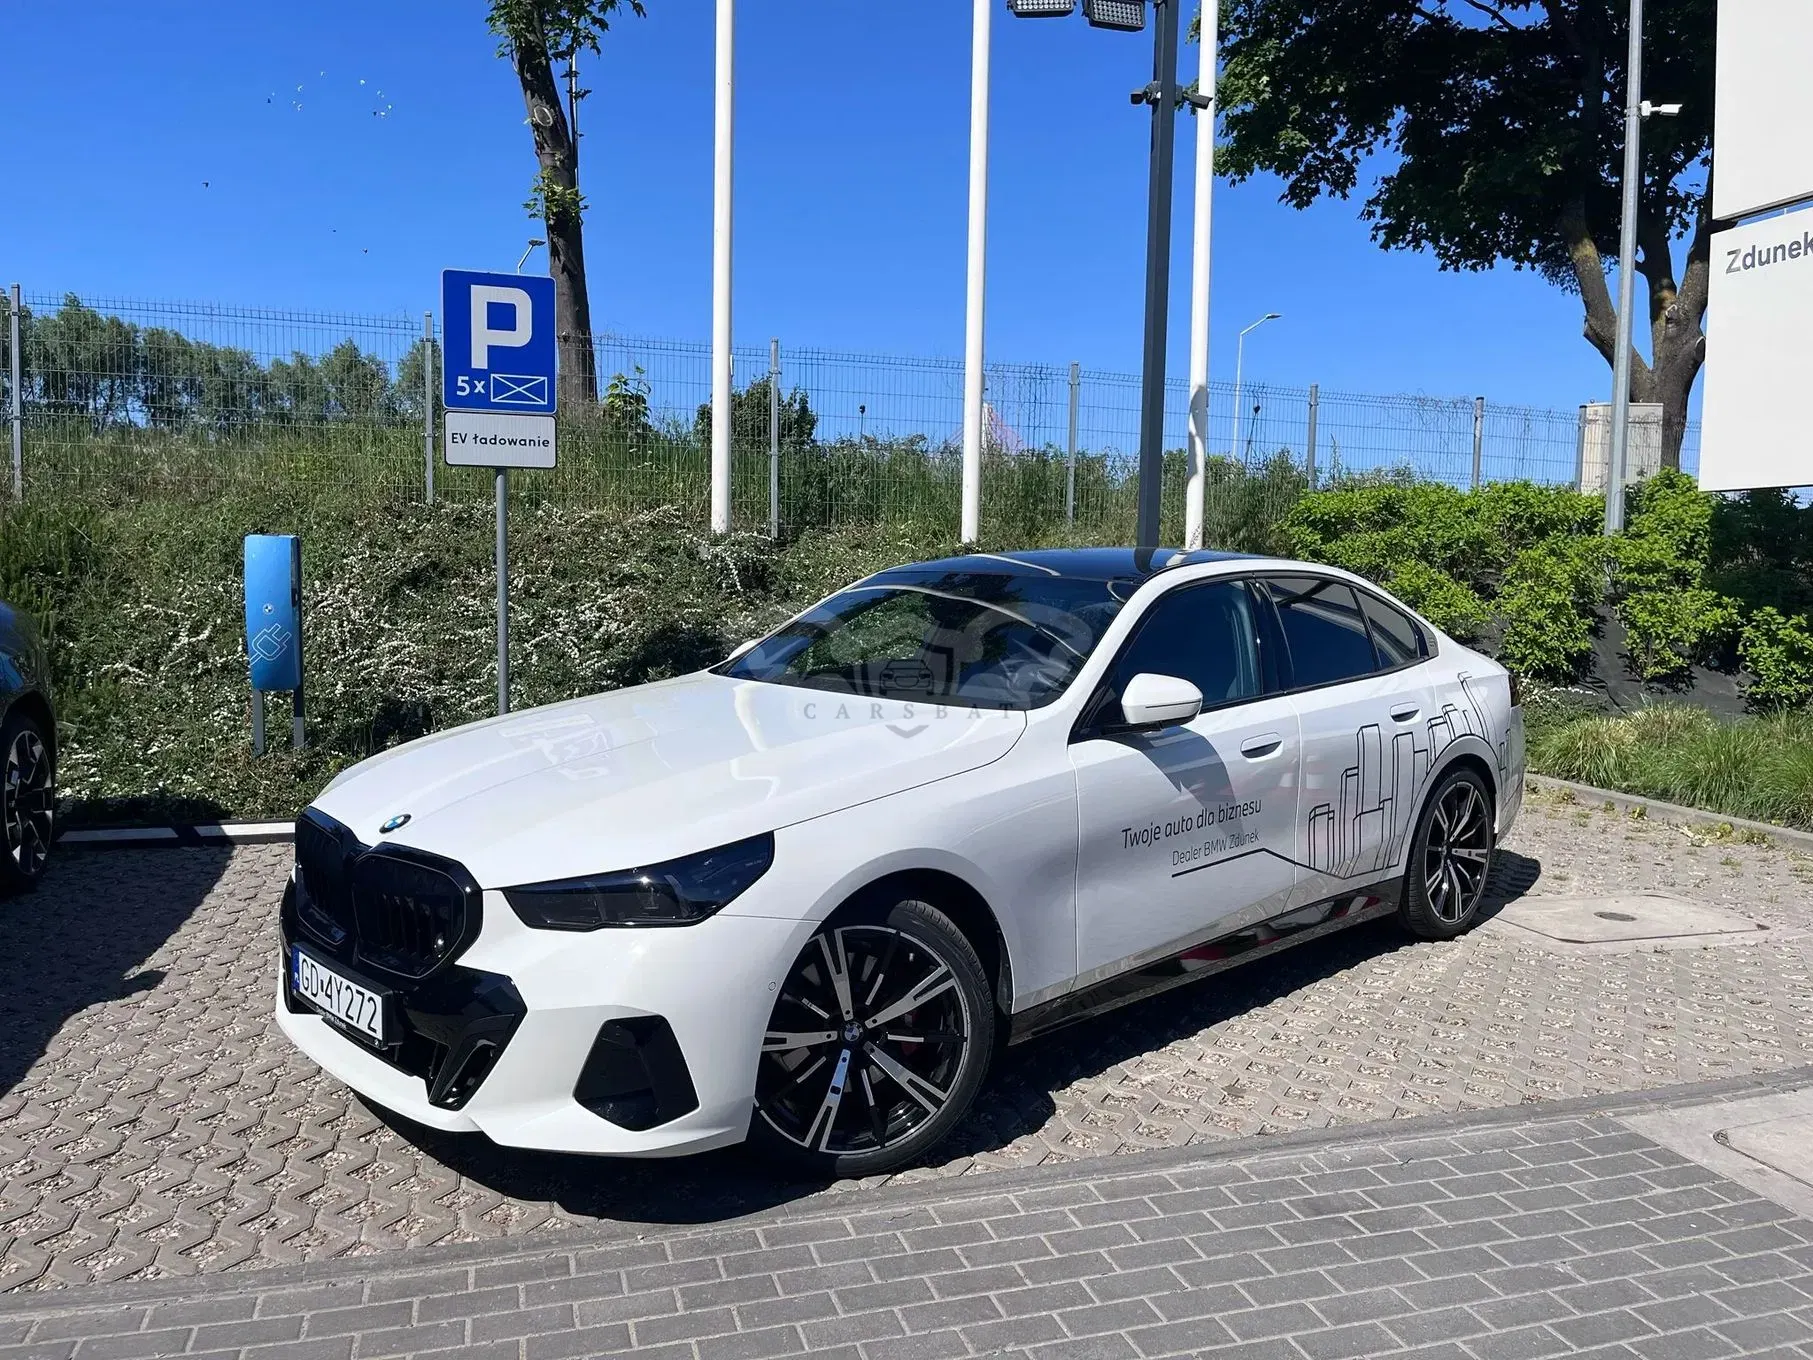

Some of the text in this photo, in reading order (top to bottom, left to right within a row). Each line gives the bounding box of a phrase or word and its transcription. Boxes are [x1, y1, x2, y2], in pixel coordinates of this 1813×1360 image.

[1726, 231, 1813, 274] Zdunek
[471, 285, 532, 369] P
[451, 432, 550, 447] EV ładowanie
[1122, 800, 1262, 848] Twoje auto dla biznesu
[1172, 828, 1260, 866] Dealer BMW Zdunek
